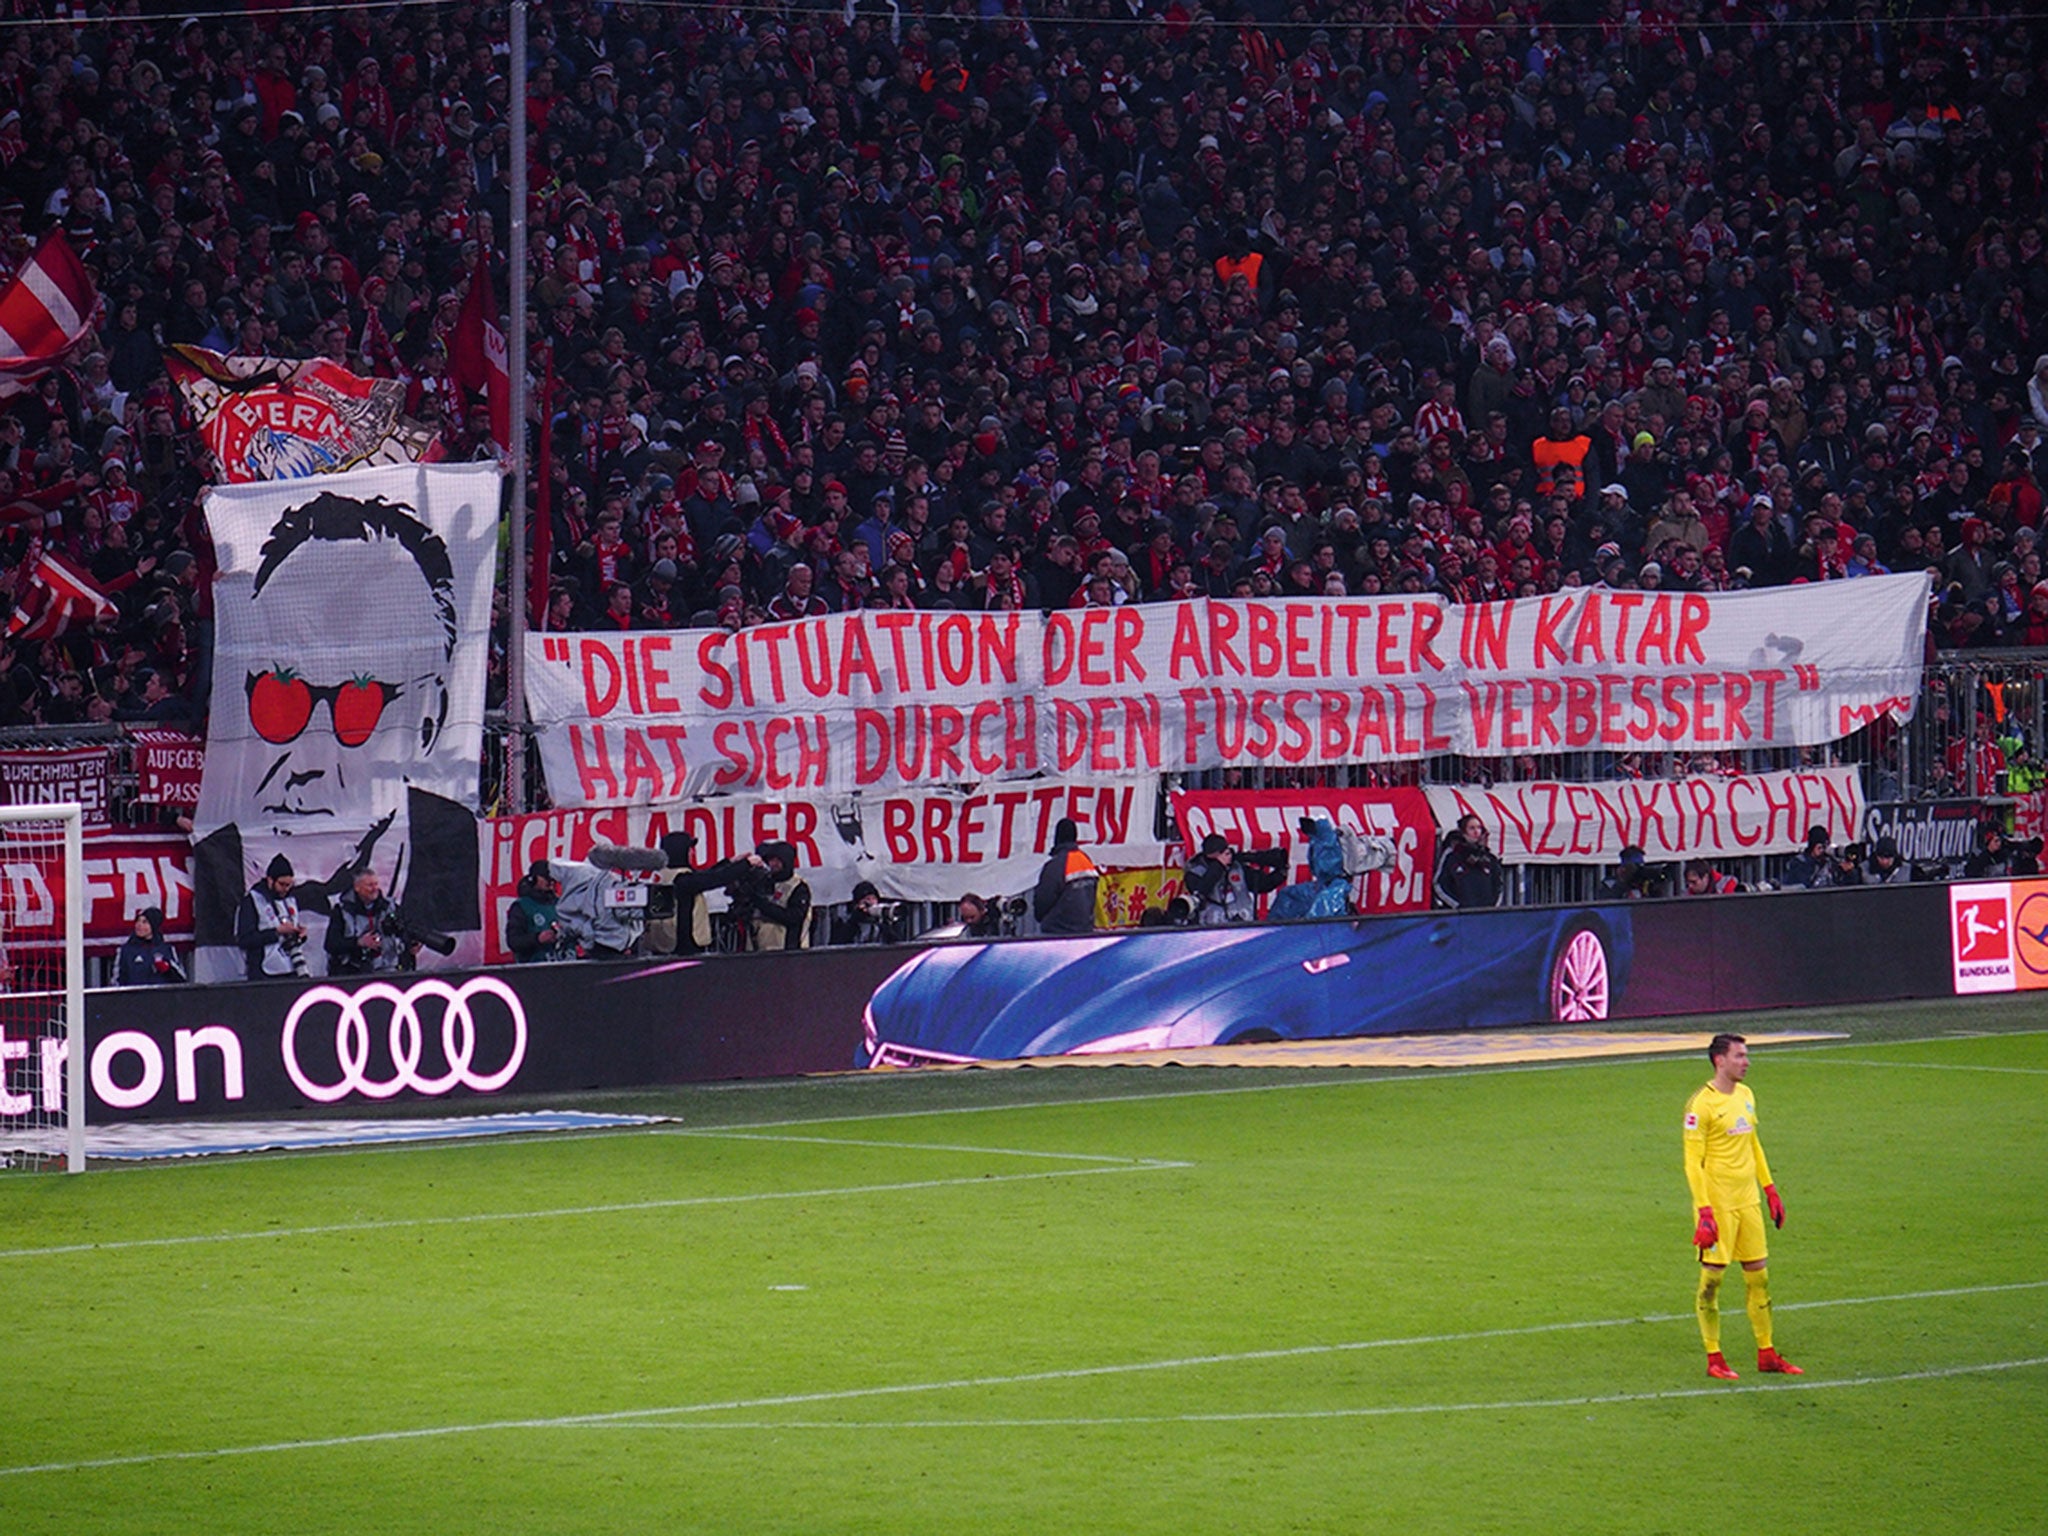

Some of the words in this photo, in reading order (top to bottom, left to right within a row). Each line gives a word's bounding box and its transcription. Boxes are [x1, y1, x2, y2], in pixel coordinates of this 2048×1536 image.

[543, 634, 682, 718] "DIE
[697, 612, 1019, 710] SITUATION
[1042, 607, 1146, 687] DER
[1169, 602, 1446, 679] ARBEITER
[1459, 599, 1514, 671] IN
[1534, 593, 1711, 669] KATAR
[2, 759, 106, 781] DURCHHALTEN
[569, 724, 687, 800] HAT
[713, 713, 831, 791] SICH
[854, 695, 1038, 786] DURCH
[1053, 692, 1161, 772] DEN
[1180, 682, 1452, 764] FUSSBALL
[1460, 663, 1820, 749] VERBESSERT"
[645, 802, 823, 869] ADLER
[883, 786, 1135, 863] BRETTEN
[1959, 965, 2011, 978] BUNDESLIGA
